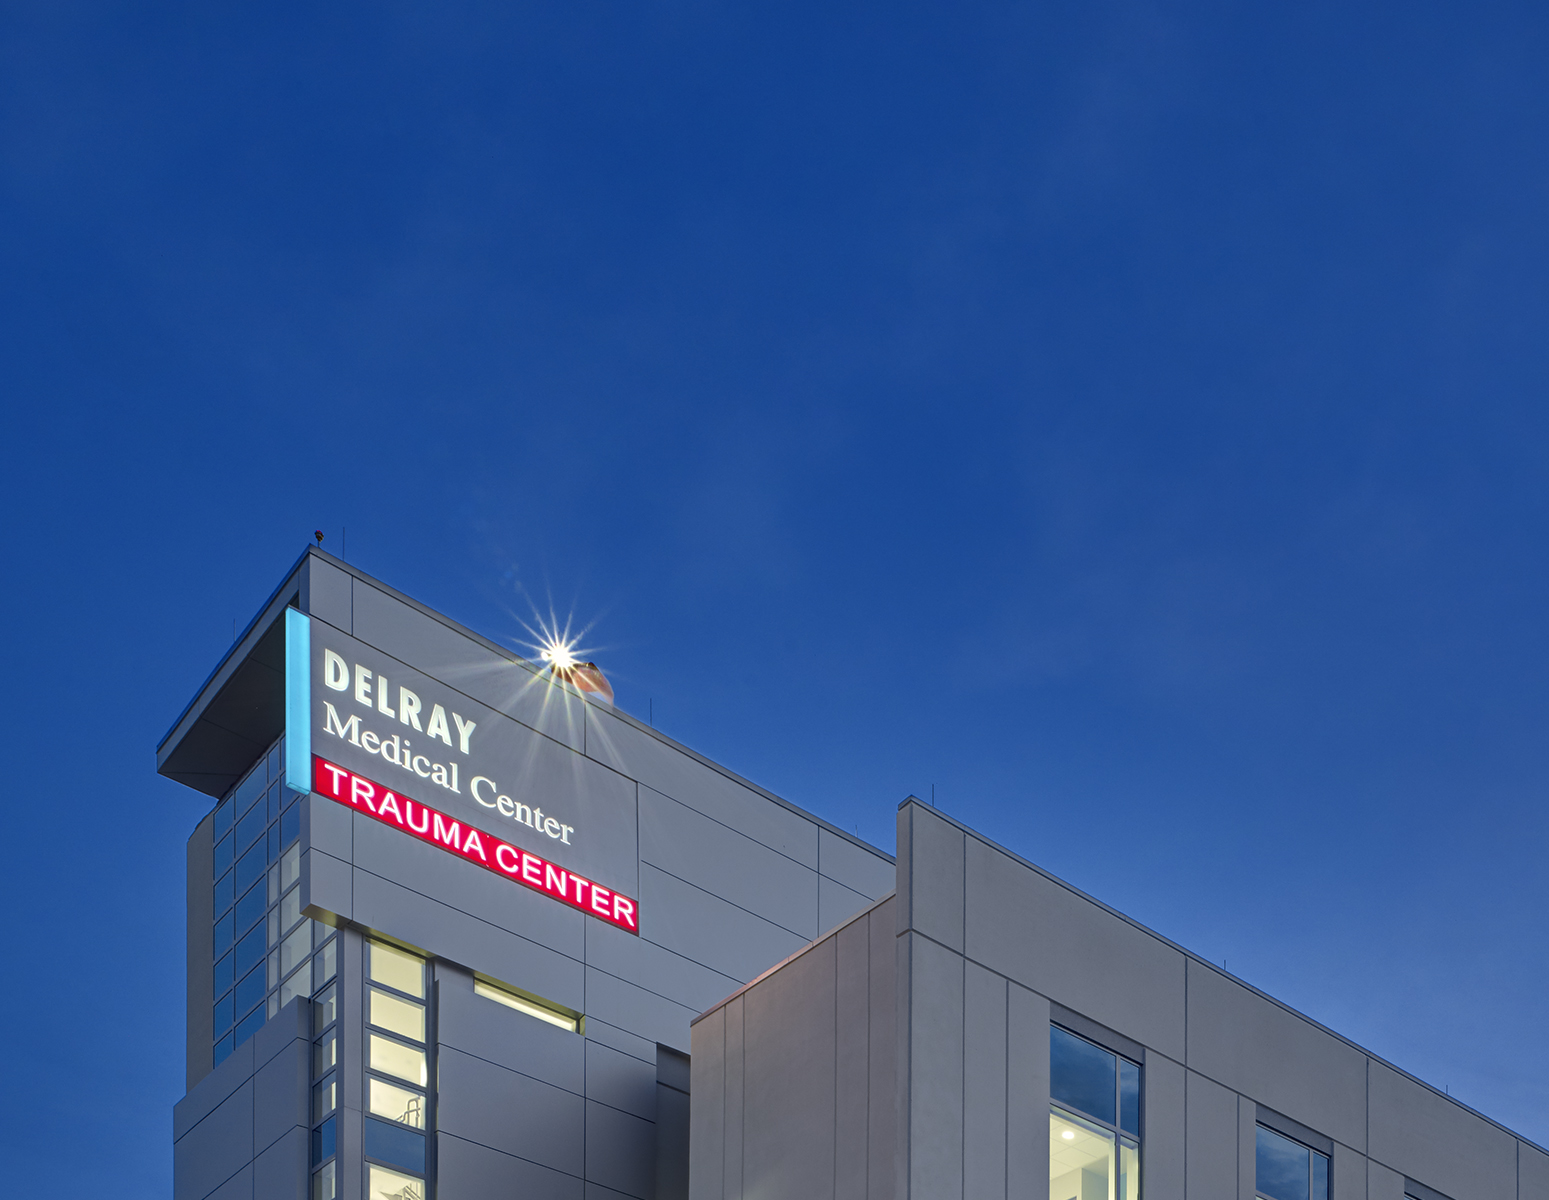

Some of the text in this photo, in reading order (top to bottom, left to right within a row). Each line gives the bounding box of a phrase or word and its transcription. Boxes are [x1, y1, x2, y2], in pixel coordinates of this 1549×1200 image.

[323, 701, 574, 845] Medical Center
[324, 648, 476, 754] DELRAY
[324, 764, 635, 927] TRAUMA CENTER
